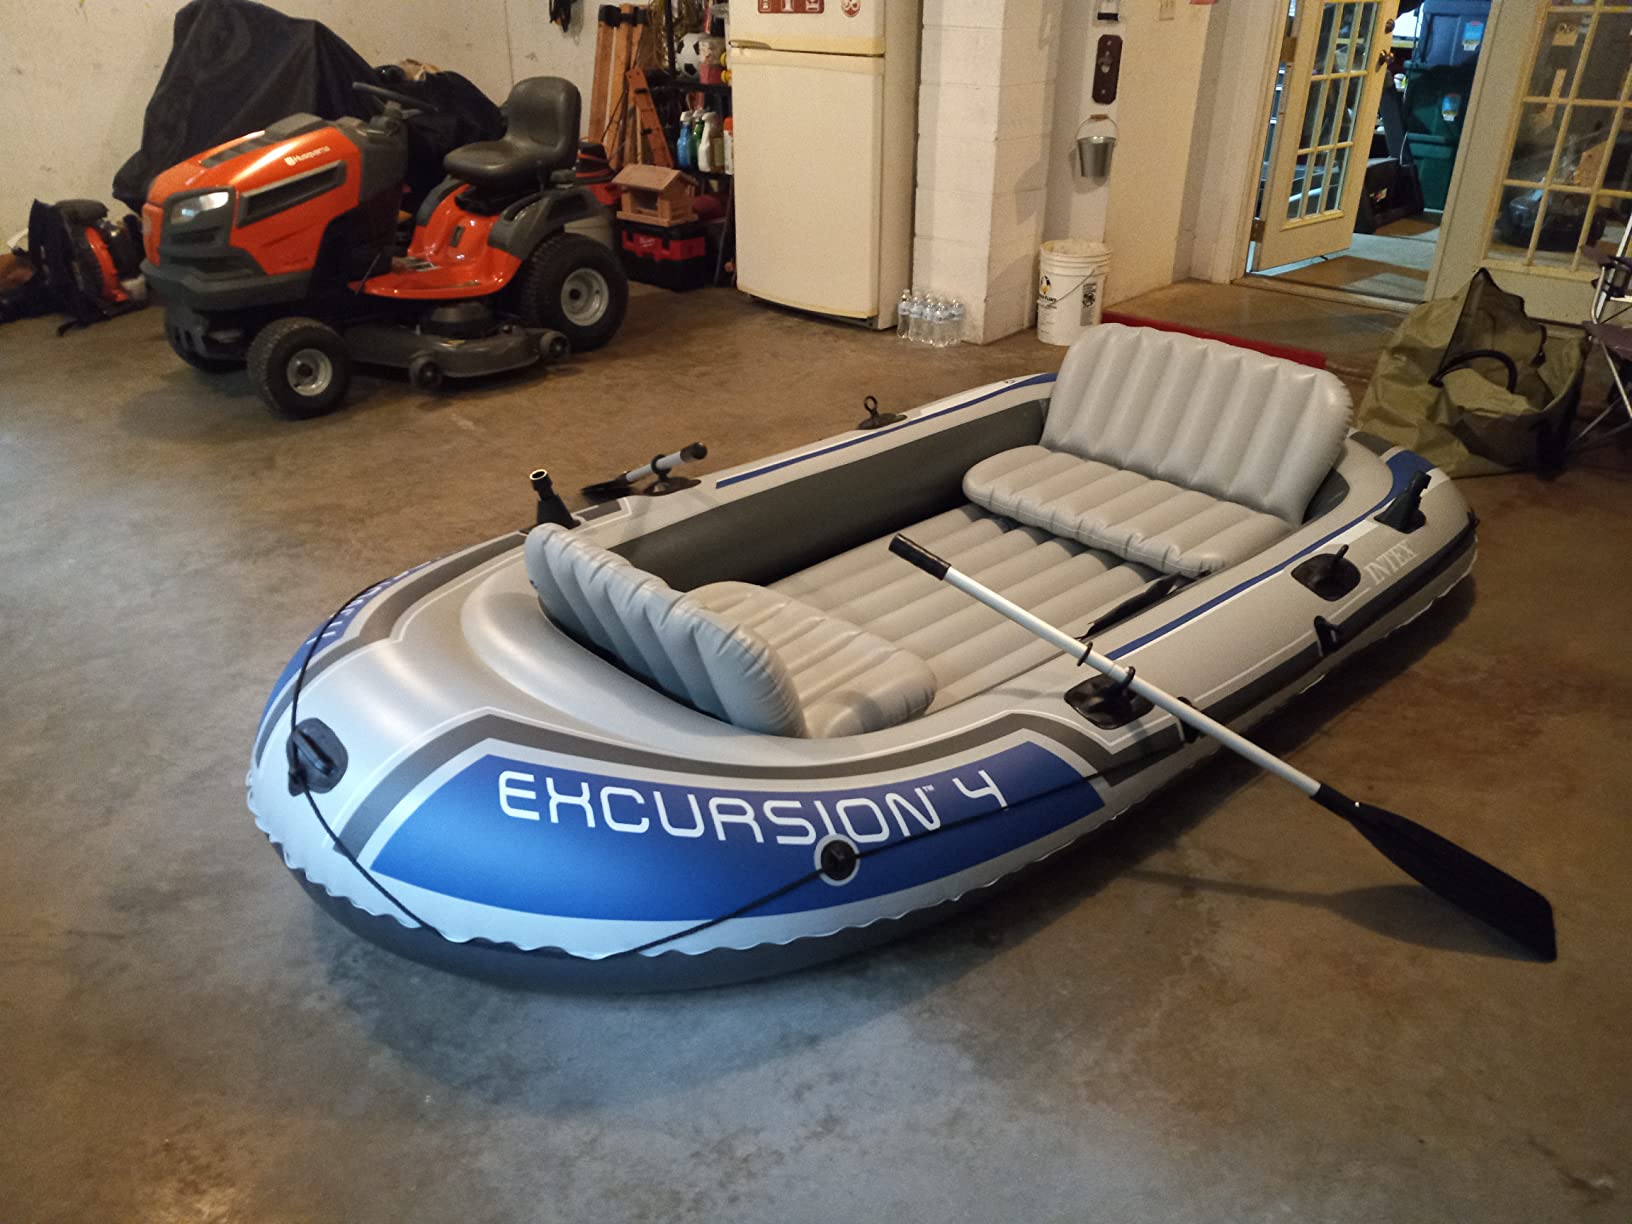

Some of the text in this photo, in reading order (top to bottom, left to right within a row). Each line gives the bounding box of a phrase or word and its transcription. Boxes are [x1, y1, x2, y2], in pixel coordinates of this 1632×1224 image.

[1364, 539, 1418, 585] INTEX
[498, 769, 942, 846] EXCURSION
[952, 769, 1009, 811] 4
